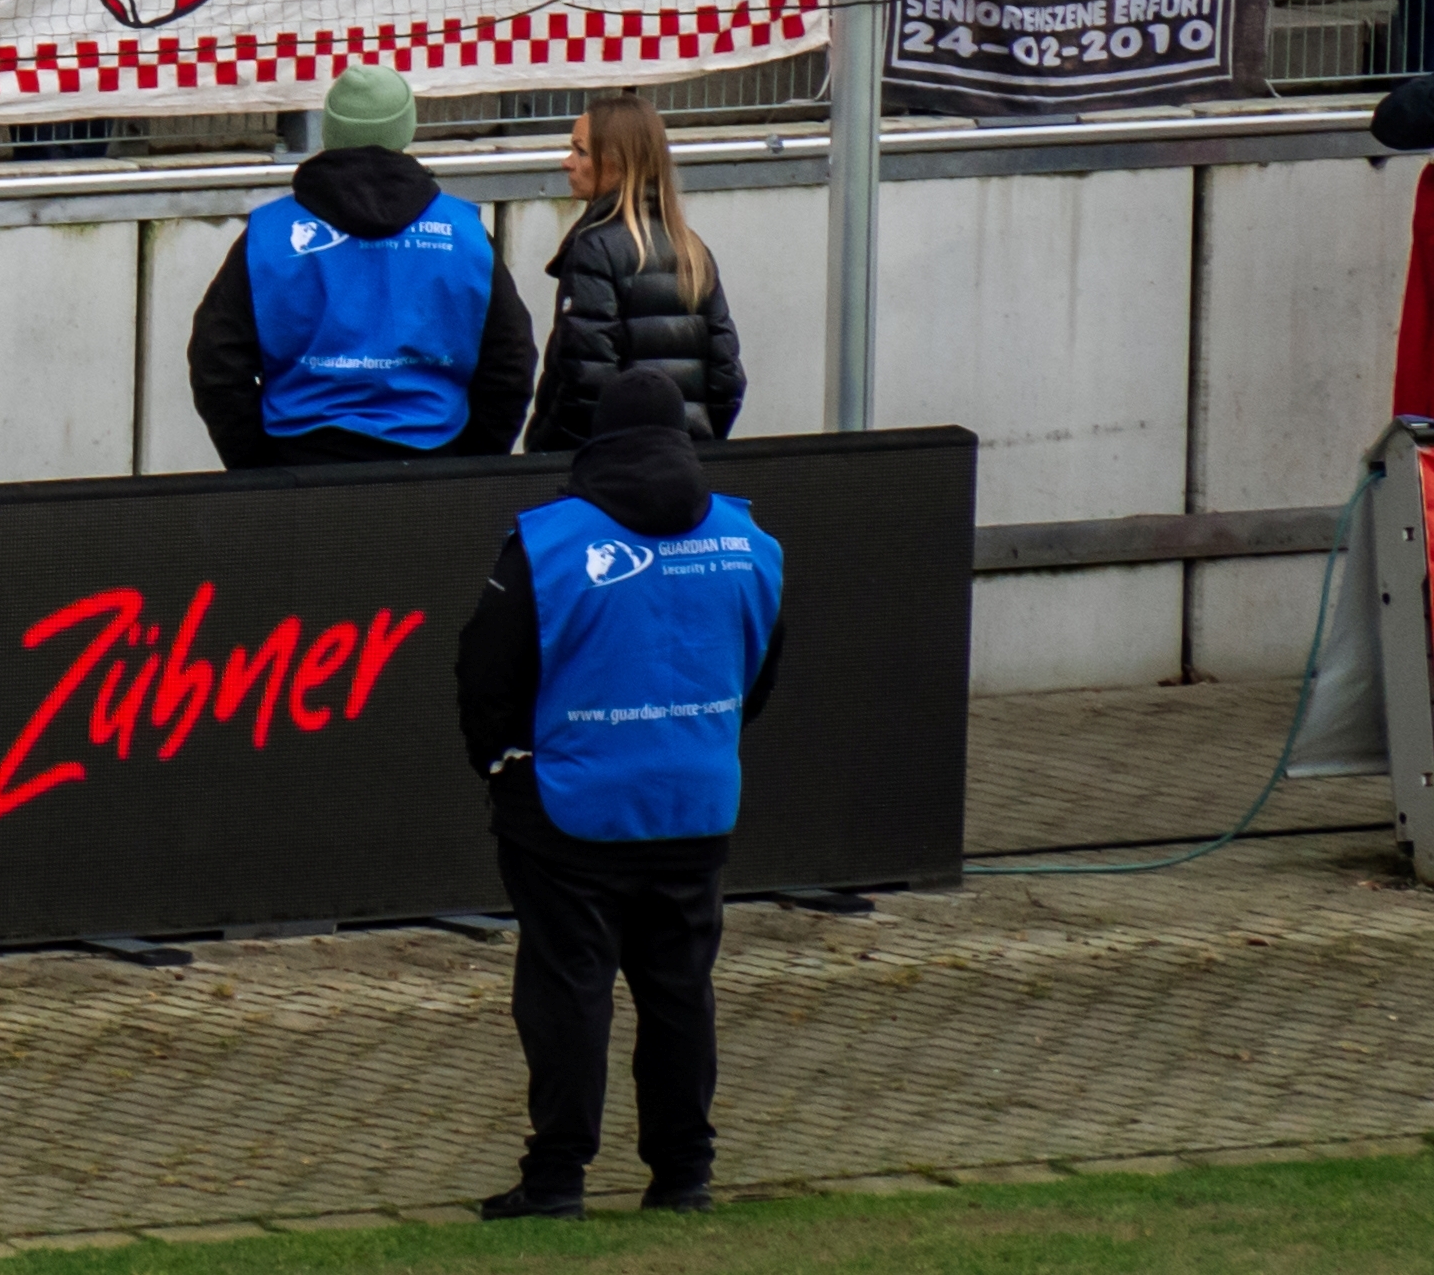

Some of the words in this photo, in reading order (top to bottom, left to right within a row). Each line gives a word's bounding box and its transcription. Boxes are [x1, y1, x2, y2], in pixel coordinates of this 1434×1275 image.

[902, 19, 1215, 68] 24-02-2010
[418, 221, 453, 237] FORCE
[658, 538, 719, 556] GUARDIAN
[719, 536, 752, 552] FORCE
[662, 561, 705, 576] Security
